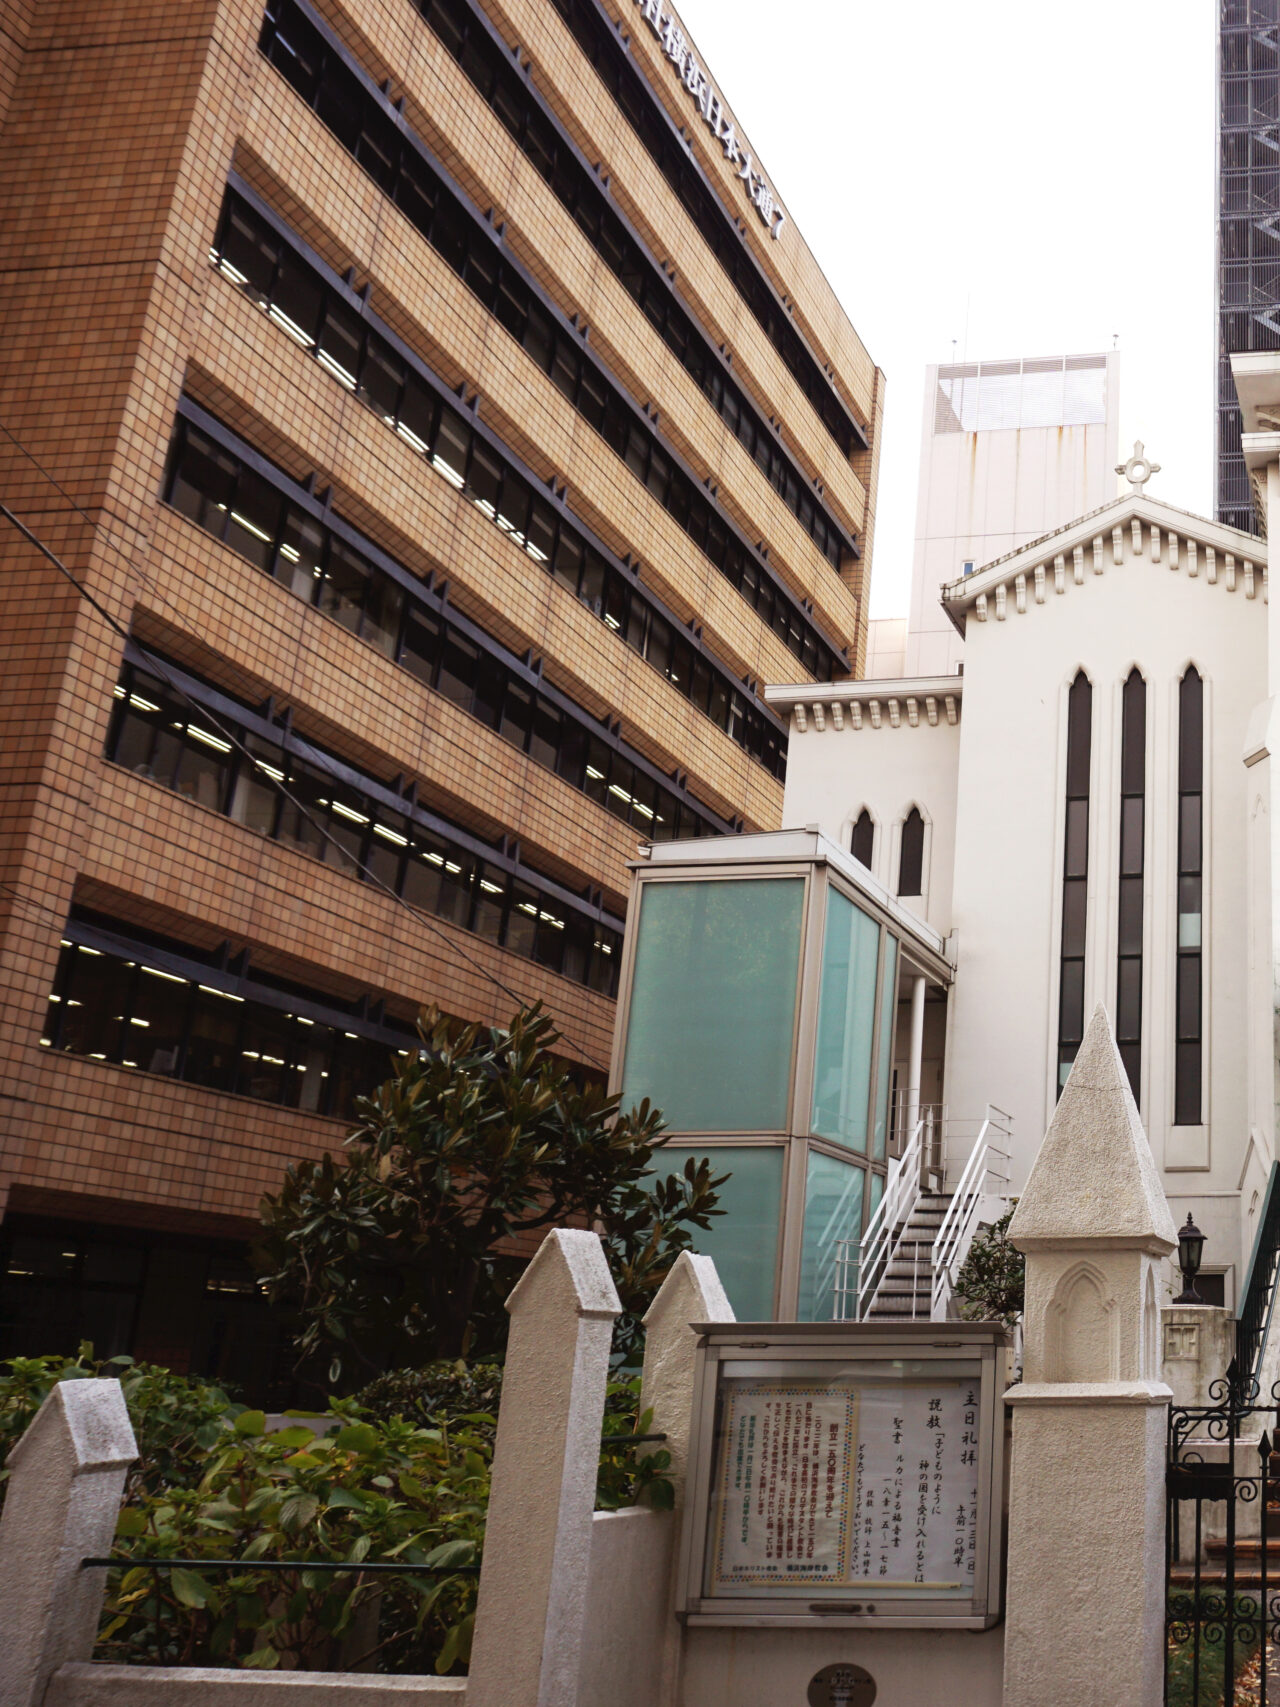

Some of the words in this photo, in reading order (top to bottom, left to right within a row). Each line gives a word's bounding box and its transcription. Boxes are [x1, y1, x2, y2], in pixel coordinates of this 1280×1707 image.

[892, 1417, 904, 1444] 聖書
[926, 1397, 944, 1430] 説教
[959, 1390, 979, 1467] 主日礼拝
[891, 1454, 905, 1548] ルカによる福音書
